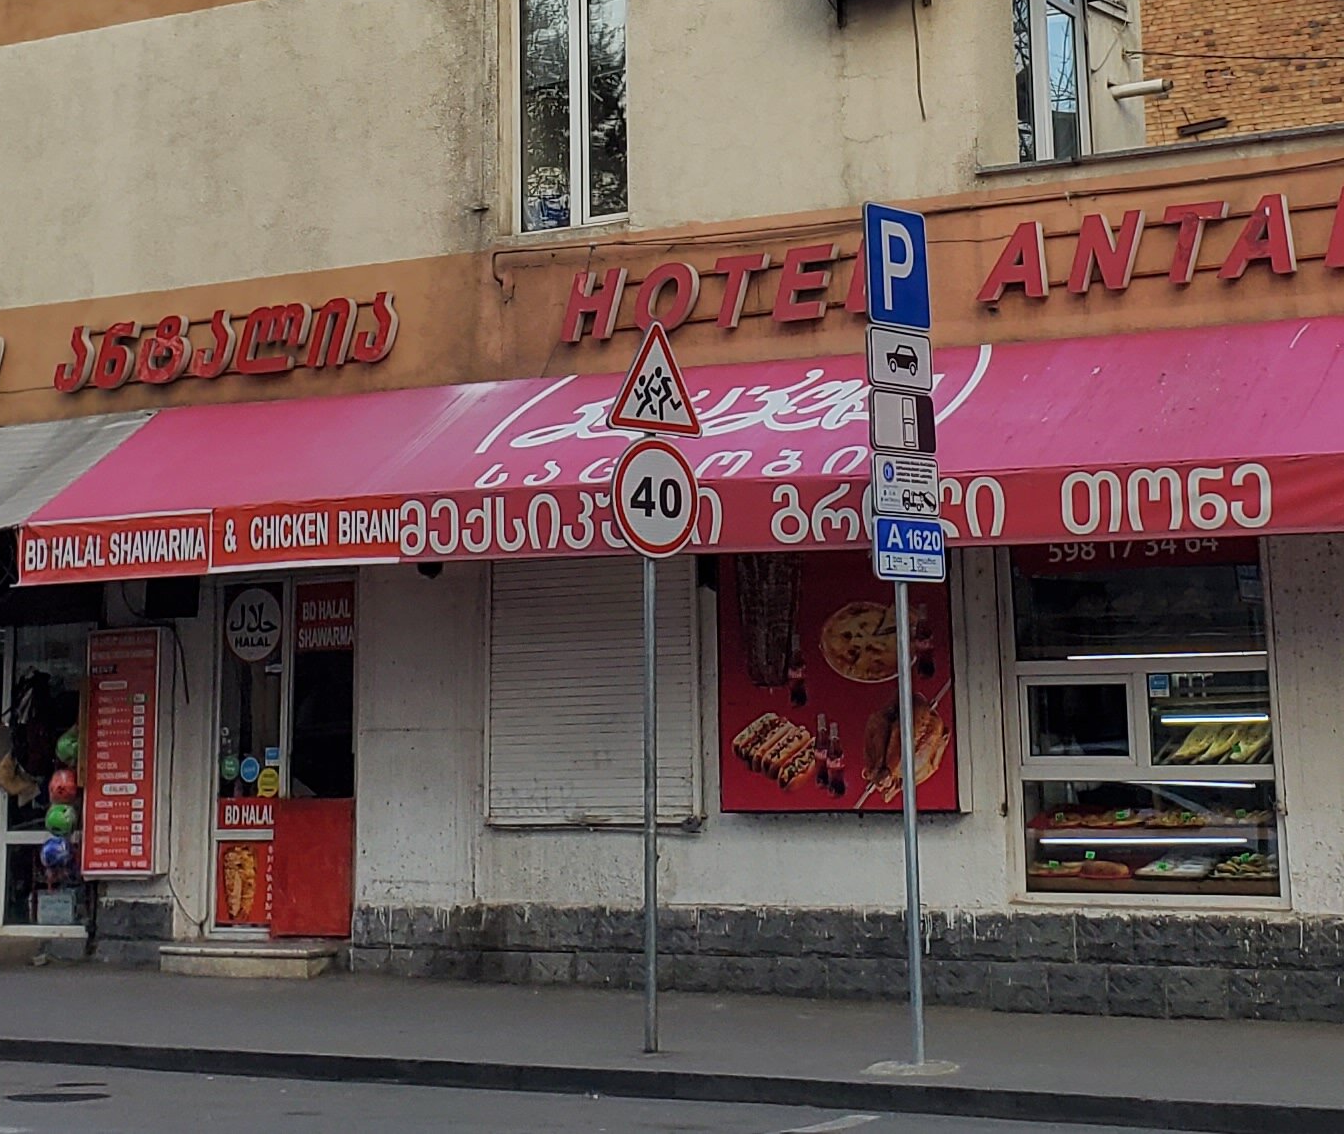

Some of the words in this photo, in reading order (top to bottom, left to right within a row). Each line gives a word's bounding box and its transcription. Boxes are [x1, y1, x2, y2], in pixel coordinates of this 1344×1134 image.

[881, 219, 914, 311] P
[53, 291, 399, 393] ანტალია
[630, 476, 682, 518] 40
[1061, 463, 1273, 533] თონე
[24, 538, 48, 572] BD
[51, 534, 106, 570] HALAL
[108, 526, 206, 567] SHAWARMA
[224, 521, 237, 553] &
[249, 510, 329, 551] CHICKEN
[337, 506, 399, 546] BIRANI
[886, 523, 904, 549] A
[906, 529, 941, 552] 1620
[229, 602, 278, 633] حلال
[302, 601, 316, 620] BD
[318, 599, 351, 618] HALAL
[234, 635, 271, 648] HALAL
[298, 627, 354, 648] SHAWARMA
[224, 805, 240, 825] BD
[242, 804, 274, 825] HALAL
